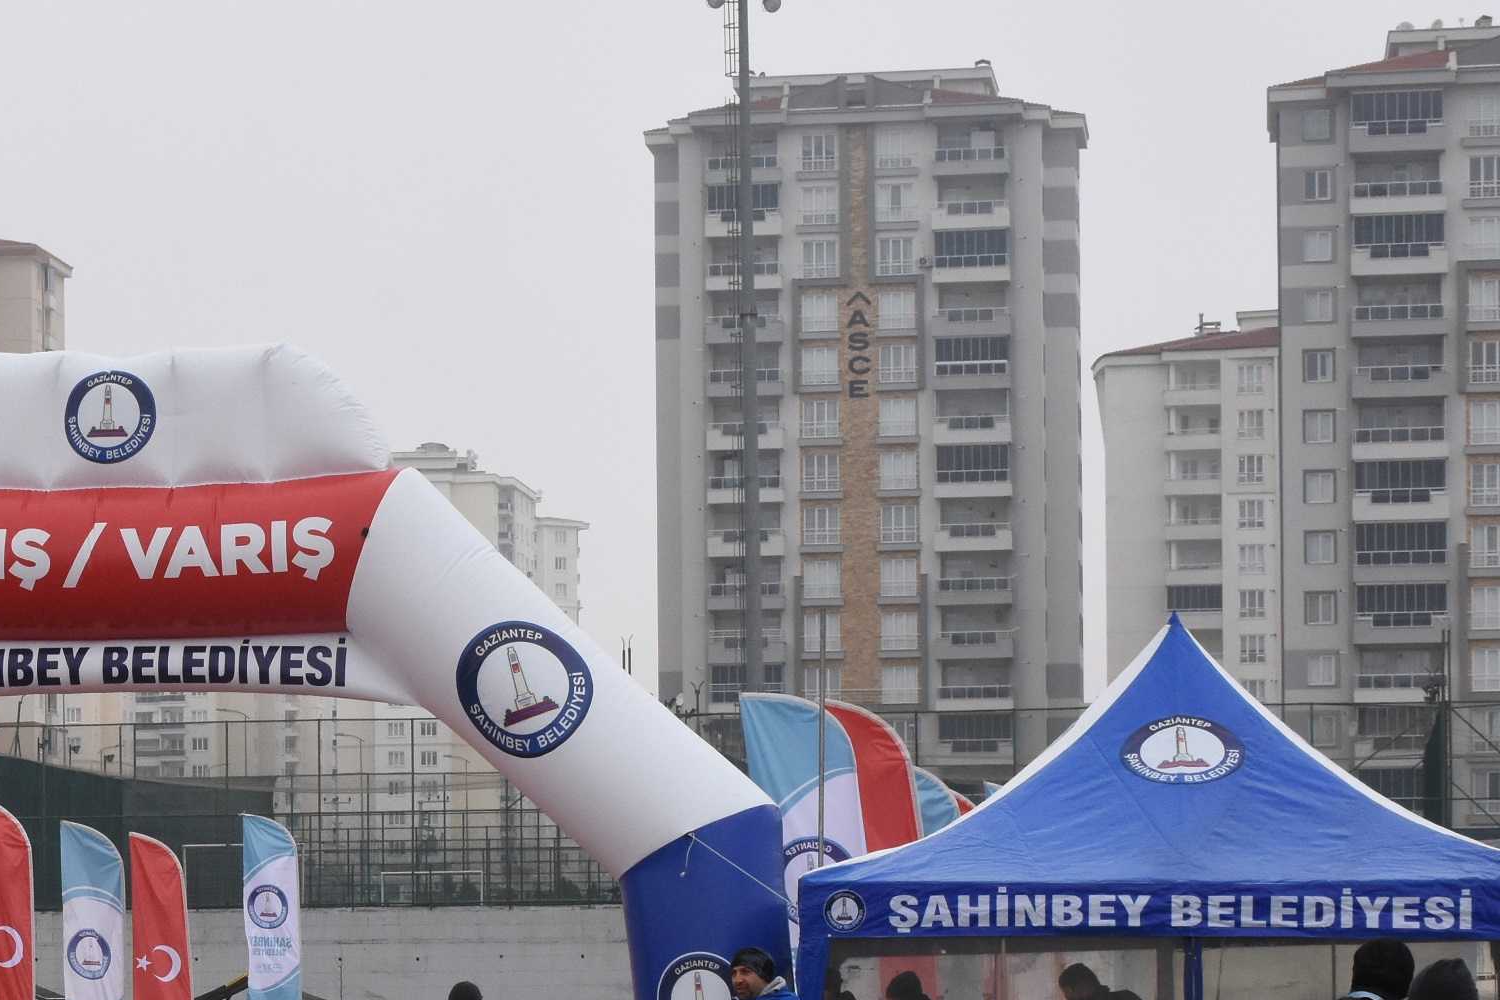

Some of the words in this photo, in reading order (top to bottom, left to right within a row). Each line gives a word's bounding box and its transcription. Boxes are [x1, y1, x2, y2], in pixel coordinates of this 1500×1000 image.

[847, 309, 871, 398] ASCE
[67, 416, 101, 459] ŞAHİNBEY
[106, 413, 152, 460] BELEDİYESİ
[62, 522, 107, 589] /
[119, 516, 336, 581] VARIŞ
[102, 637, 348, 686] BELEDİYESİ
[475, 628, 543, 657] GAZİANTEP
[470, 703, 531, 752] ŞAHİNBEY
[536, 671, 586, 748] BELEDİYESİ
[1149, 716, 1212, 731] GAZİANTEP
[1124, 753, 1178, 782] ŞAHİNBEY
[1184, 749, 1240, 783] BELEDİYESİ
[888, 886, 1152, 934] ŞAHİNBEY
[1170, 887, 1474, 932] BELEDİYESİ
[674, 959, 720, 975] GAZİANTEP
